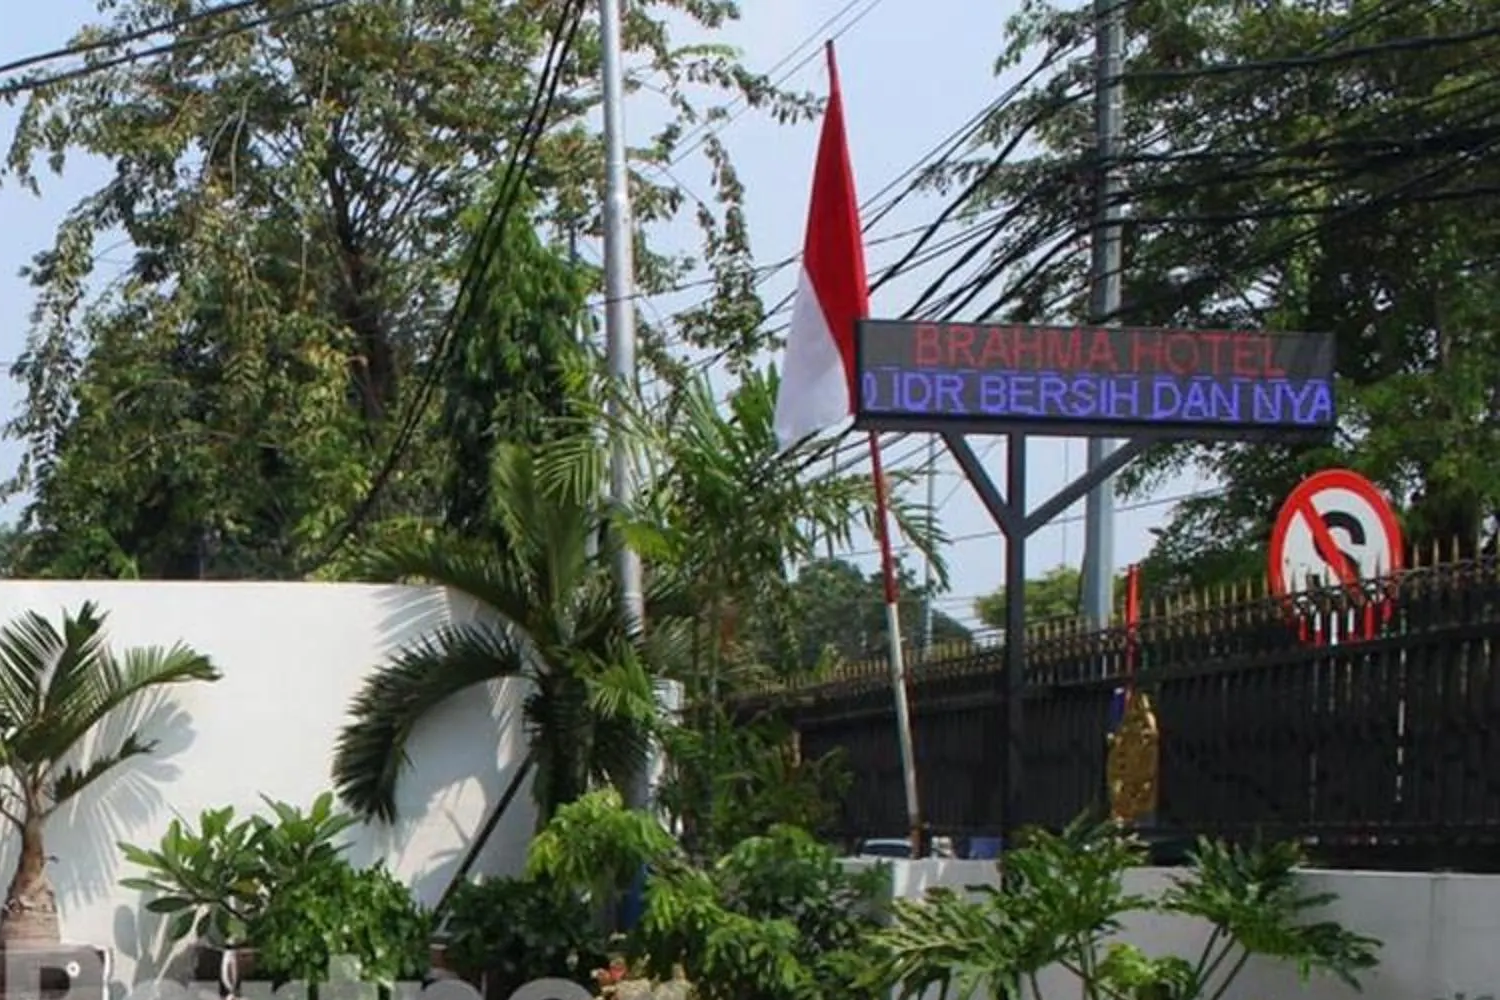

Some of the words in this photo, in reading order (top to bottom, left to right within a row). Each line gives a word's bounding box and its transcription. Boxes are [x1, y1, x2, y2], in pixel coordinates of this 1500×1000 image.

[914, 325, 1119, 372] BRAHMA
[1130, 331, 1286, 378] HOTEL
[892, 371, 967, 413] IDR
[980, 374, 1140, 418] BERSIH
[1152, 380, 1241, 421] DAN
[1253, 382, 1332, 423] NYA
